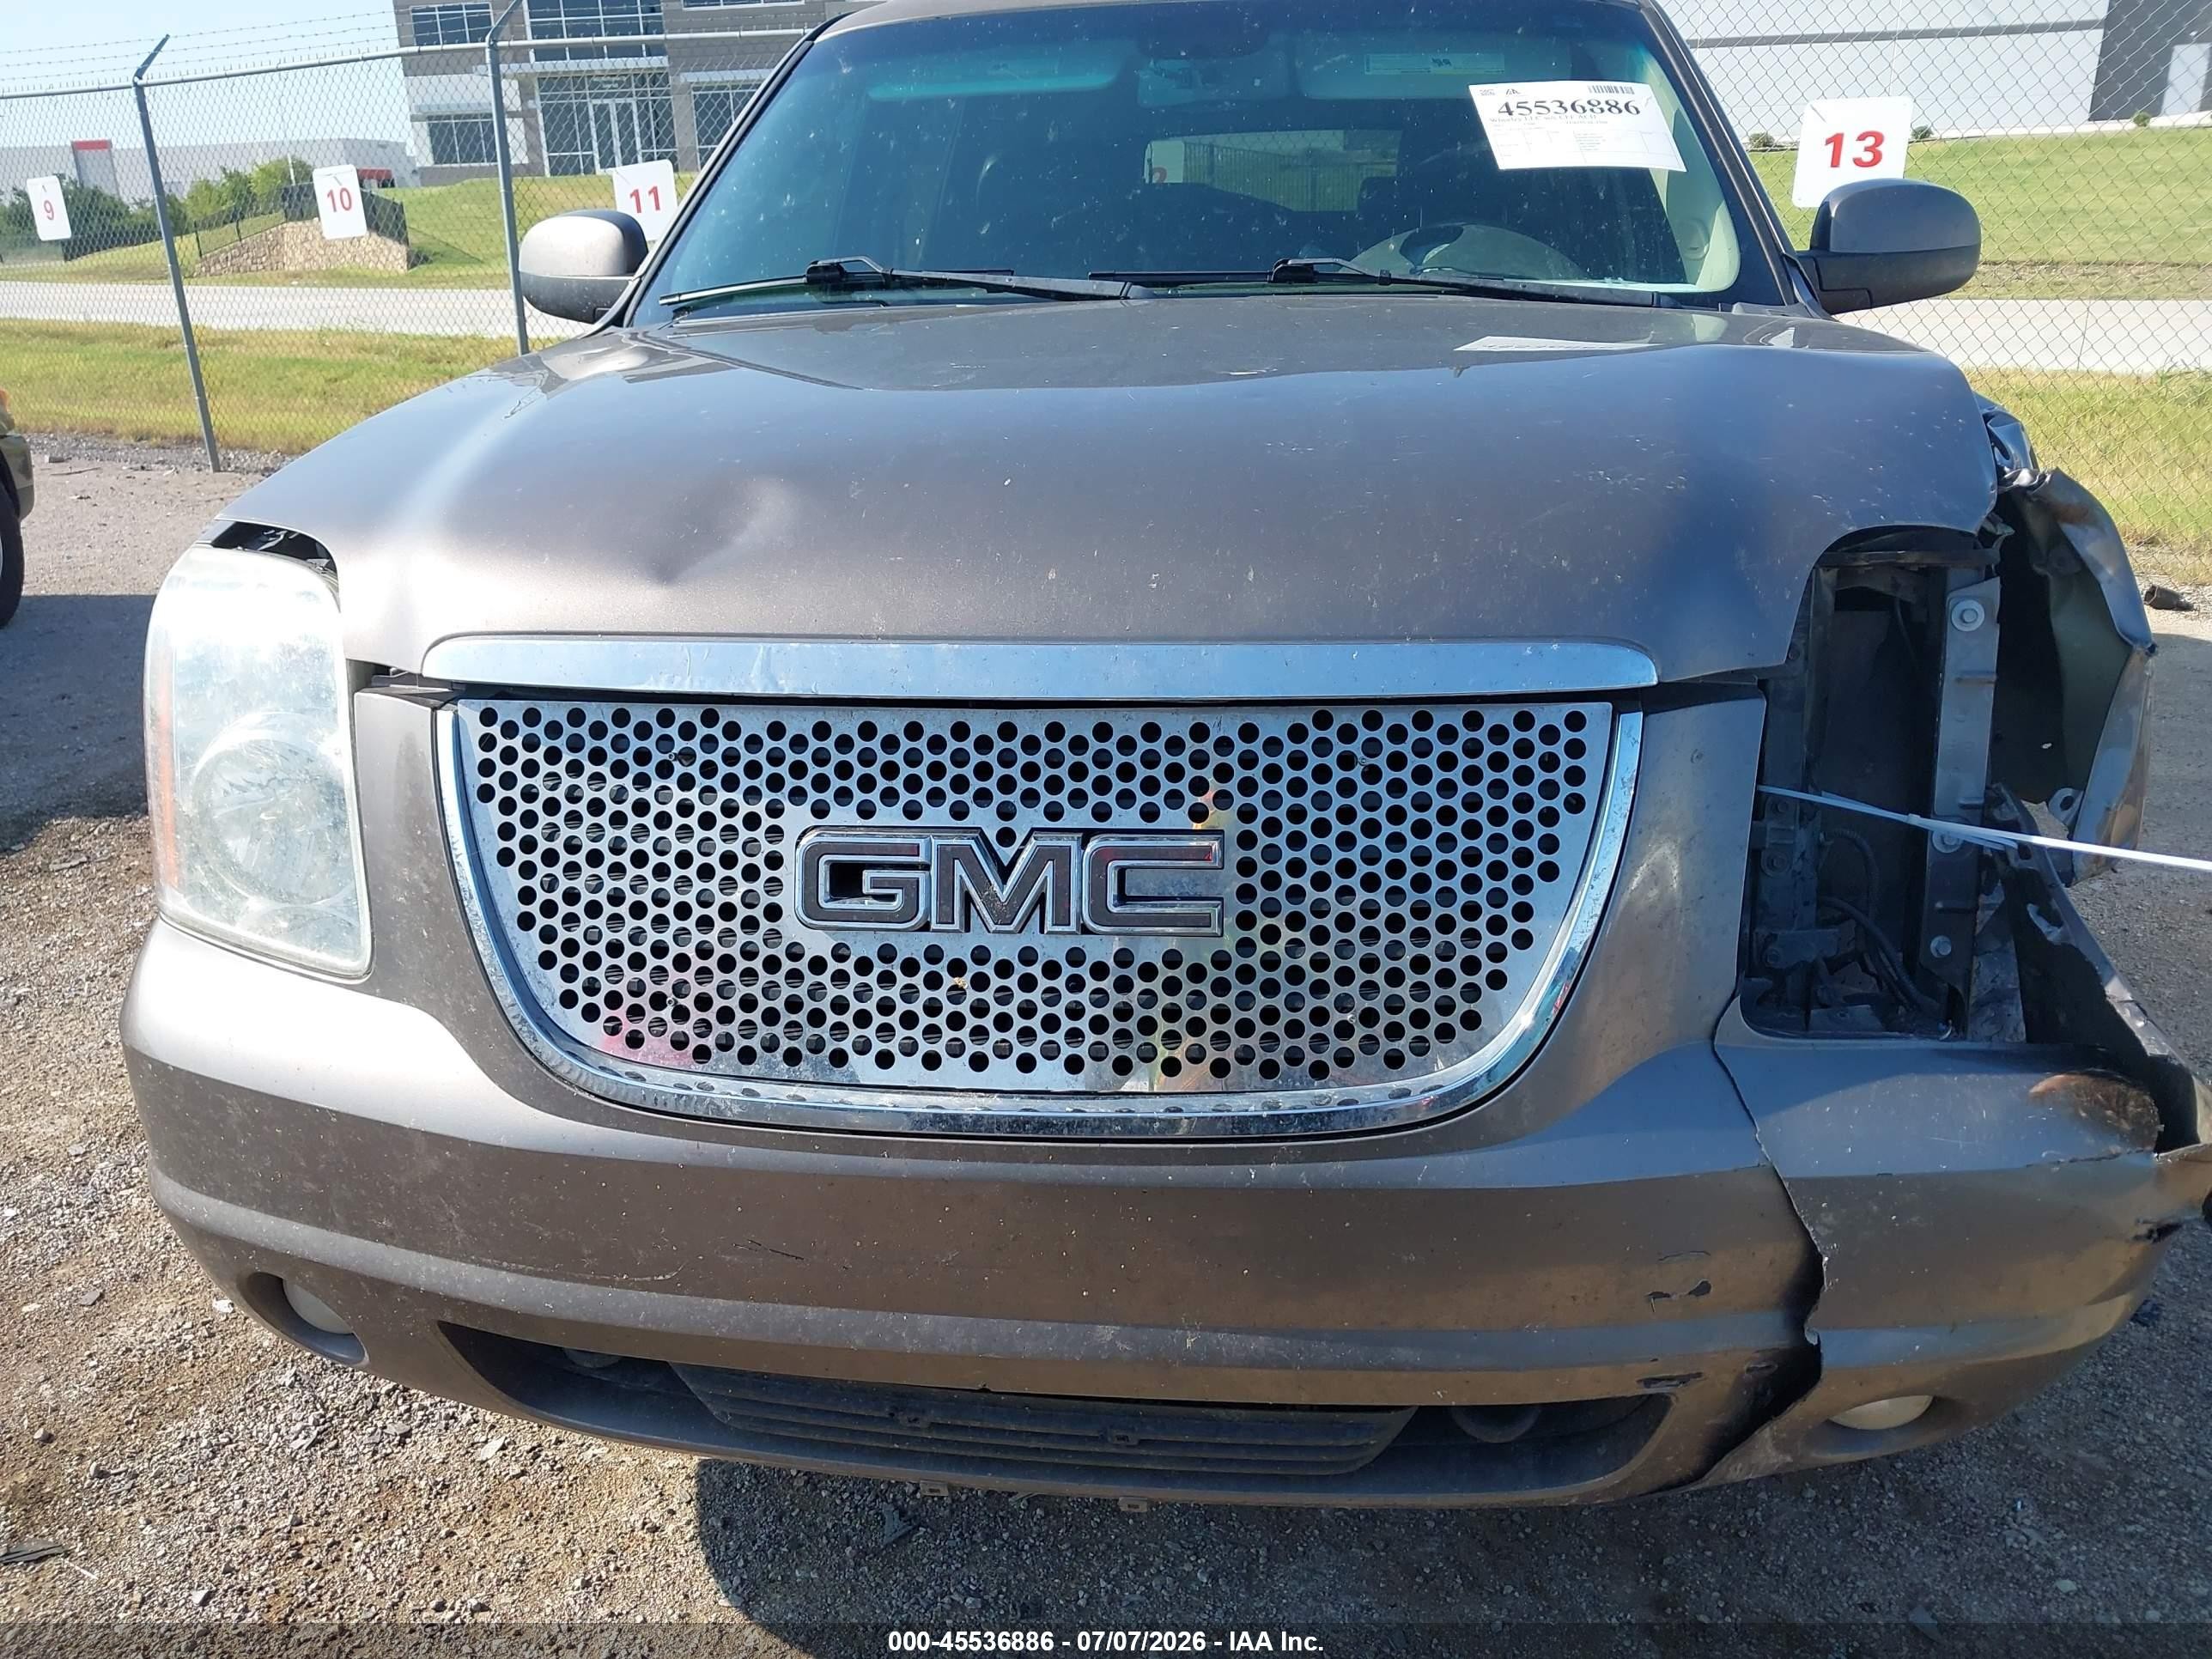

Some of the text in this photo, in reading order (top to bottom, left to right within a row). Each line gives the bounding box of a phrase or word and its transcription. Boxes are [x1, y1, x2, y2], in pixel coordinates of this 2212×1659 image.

[1498, 99, 1641, 116] 45536886
[1825, 131, 1885, 168] 13
[44, 200, 54, 221] 9
[327, 187, 352, 213] 10
[629, 185, 660, 214] 11
[794, 826, 1224, 937] GMC
